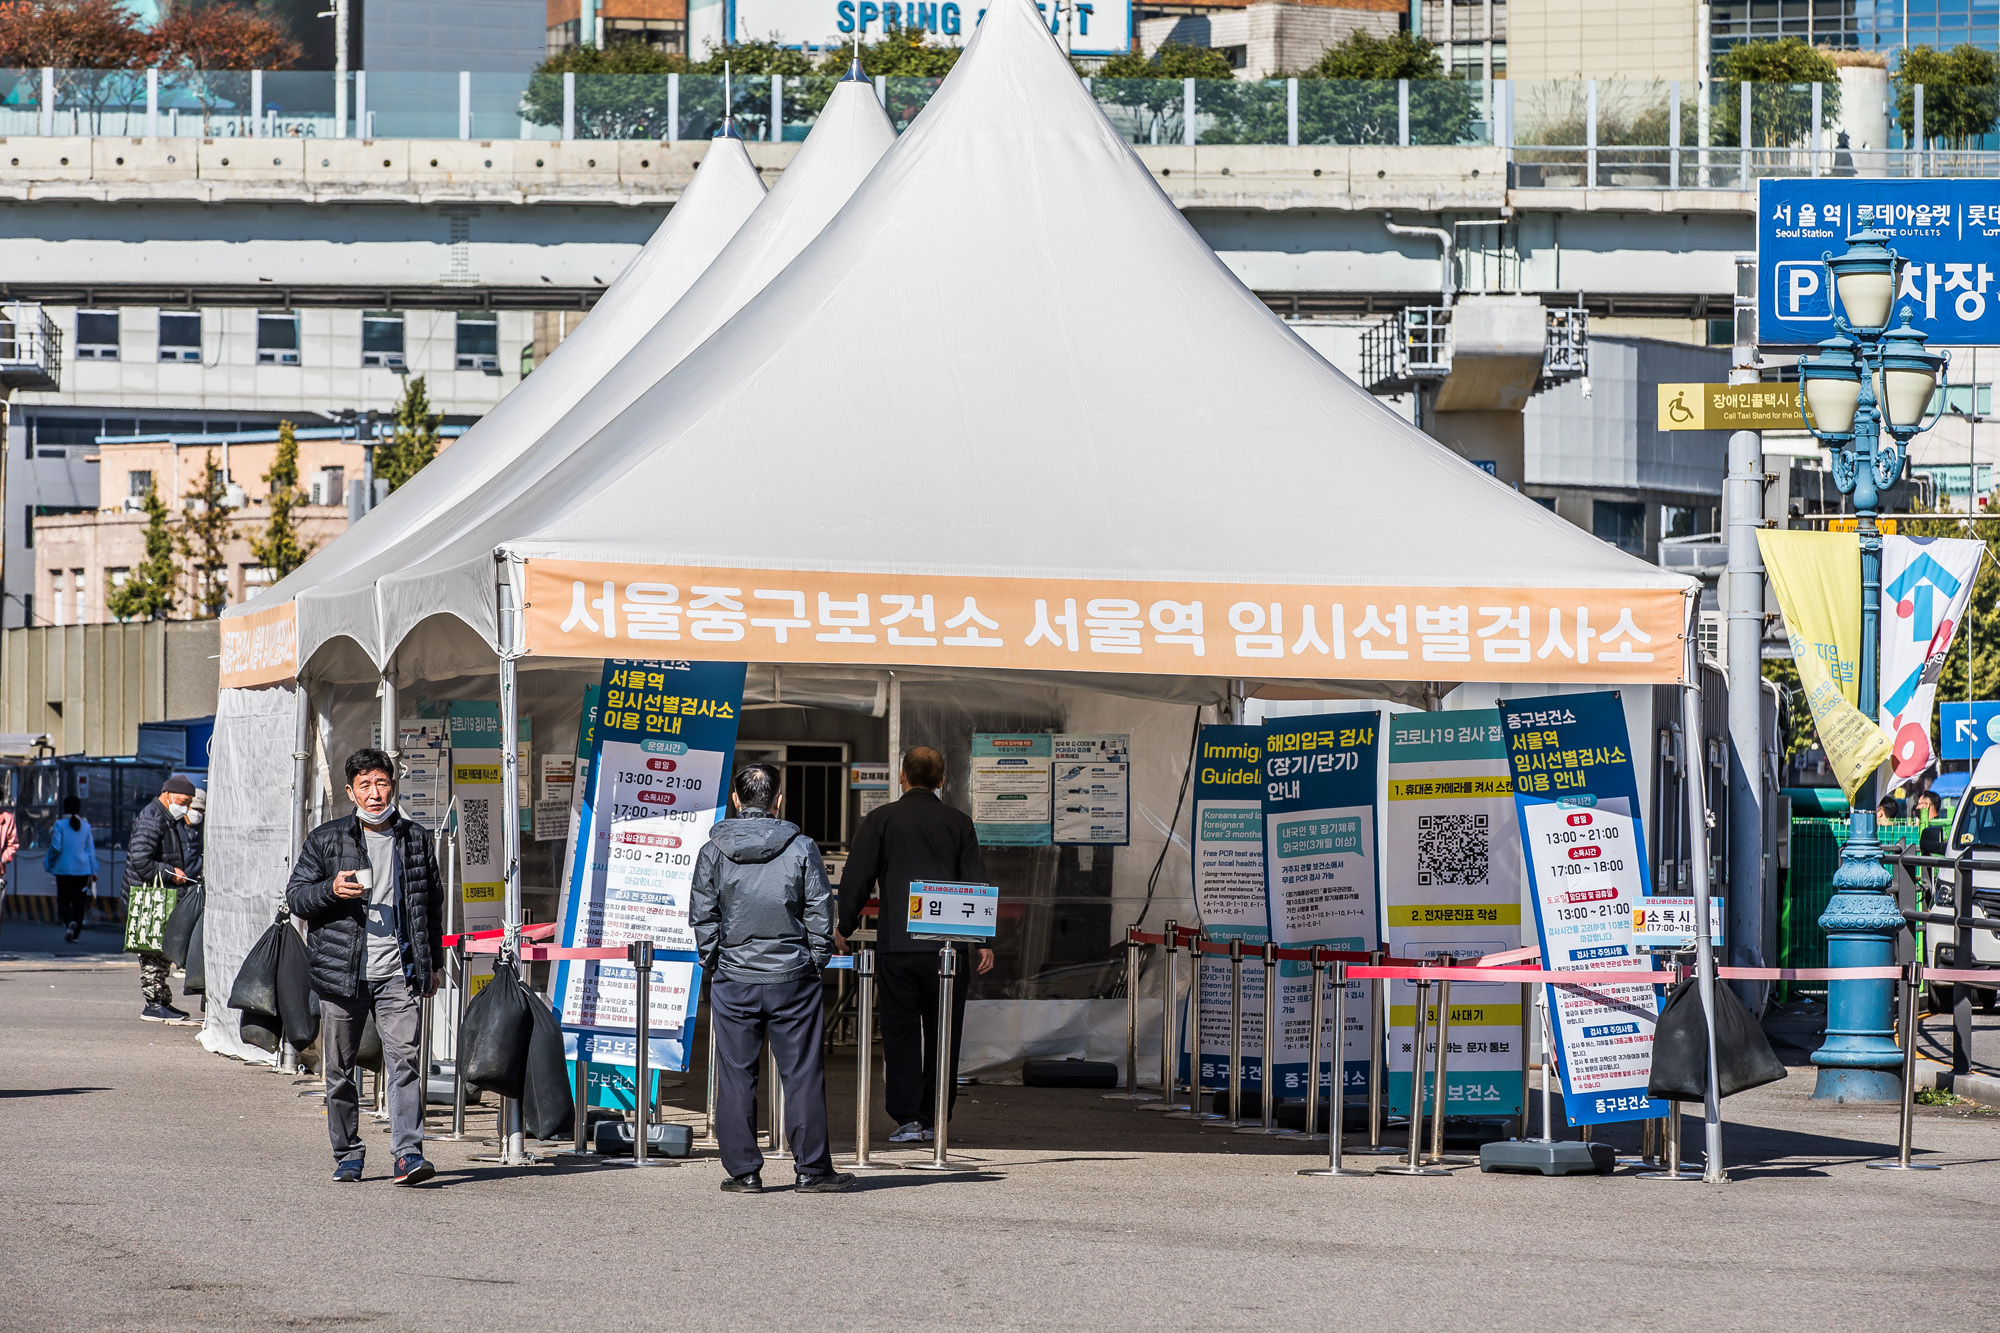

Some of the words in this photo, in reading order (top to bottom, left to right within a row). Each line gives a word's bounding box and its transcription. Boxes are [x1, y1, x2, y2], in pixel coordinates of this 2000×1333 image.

[837, 1, 961, 36] SPRING
[1772, 203, 1842, 228] 서울역
[1775, 228, 1801, 238] Seoul
[1801, 228, 1834, 239] Station
[1899, 228, 1941, 238] OUTLETS
[1789, 268, 1820, 313] P
[1712, 392, 1789, 409] 장애인콜택시
[1723, 412, 1737, 420] Call
[1737, 412, 1752, 420] Taxi
[1751, 411, 1771, 420] Stand
[1771, 411, 1781, 420] for
[1781, 411, 1793, 420] the
[560, 580, 1004, 649] 서울중구보건소
[1024, 597, 1206, 657] 서울역
[1227, 600, 1655, 665] 임시선별검사소
[609, 669, 665, 692] 서울역
[607, 690, 734, 719] 임시선별검사소
[451, 717, 474, 732] 코로나19
[475, 717, 486, 731] 검사
[603, 710, 641, 732] 이용
[645, 713, 682, 735] 안내
[1506, 708, 1577, 730] 중구보건소
[1266, 730, 1335, 753] 해외입국
[1338, 727, 1374, 747] 검사
[1394, 727, 1454, 746] 코로나19
[1457, 727, 1485, 743] 검사
[1512, 730, 1559, 751] 서울역
[647, 740, 682, 754] 운영시간
[653, 760, 670, 771] 평일
[1266, 751, 1359, 778] (장기/단기)
[1513, 746, 1627, 773] 임시선별검사소
[618, 771, 653, 787] 13:00
[665, 776, 703, 791] 21:00
[1394, 785, 1404, 796] 1.
[1405, 783, 1433, 796] 휴대폰
[1434, 781, 1473, 795] 카메라를
[1474, 781, 1494, 793] 켜서
[1517, 773, 1550, 792] 이용
[1553, 769, 1587, 790] 안내
[1267, 780, 1301, 802] 안내
[1975, 792, 1999, 803] 452
[614, 803, 649, 818] 17:00
[662, 808, 698, 823] 18:00
[1204, 811, 1237, 820] Koreans
[1238, 811, 1254, 820] and
[1572, 815, 1588, 825] 평일
[1203, 829, 1224, 839] (over
[1225, 830, 1231, 838] 3
[1204, 821, 1245, 831] foreigners
[1282, 826, 1307, 839] 내국인
[1308, 824, 1318, 836] 및
[1320, 821, 1357, 836] 장기체류
[1282, 838, 1334, 854] 외국인(3개월
[1334, 835, 1357, 849] 이상)
[1545, 831, 1577, 845] 13:00
[1588, 827, 1620, 841] 21:00
[654, 851, 691, 866] 21:00
[1202, 860, 1217, 869] your
[1218, 859, 1235, 867] local
[1235, 860, 1257, 868] health
[1312, 860, 1344, 871] 보건소에서
[1550, 864, 1582, 878] 17:00
[1593, 859, 1624, 873] 18:00
[1295, 874, 1309, 883] PCR
[1411, 910, 1422, 921] 2.
[1424, 909, 1475, 921] 전자문진표
[1477, 908, 1498, 921] 작성
[1557, 907, 1588, 921] 13:00
[1598, 902, 1630, 917] 21:00
[1350, 991, 1365, 1000] 검사
[1466, 1041, 1488, 1053] 문자
[1489, 1041, 1510, 1053] 통보
[1595, 1095, 1650, 1114] 중구보건소
